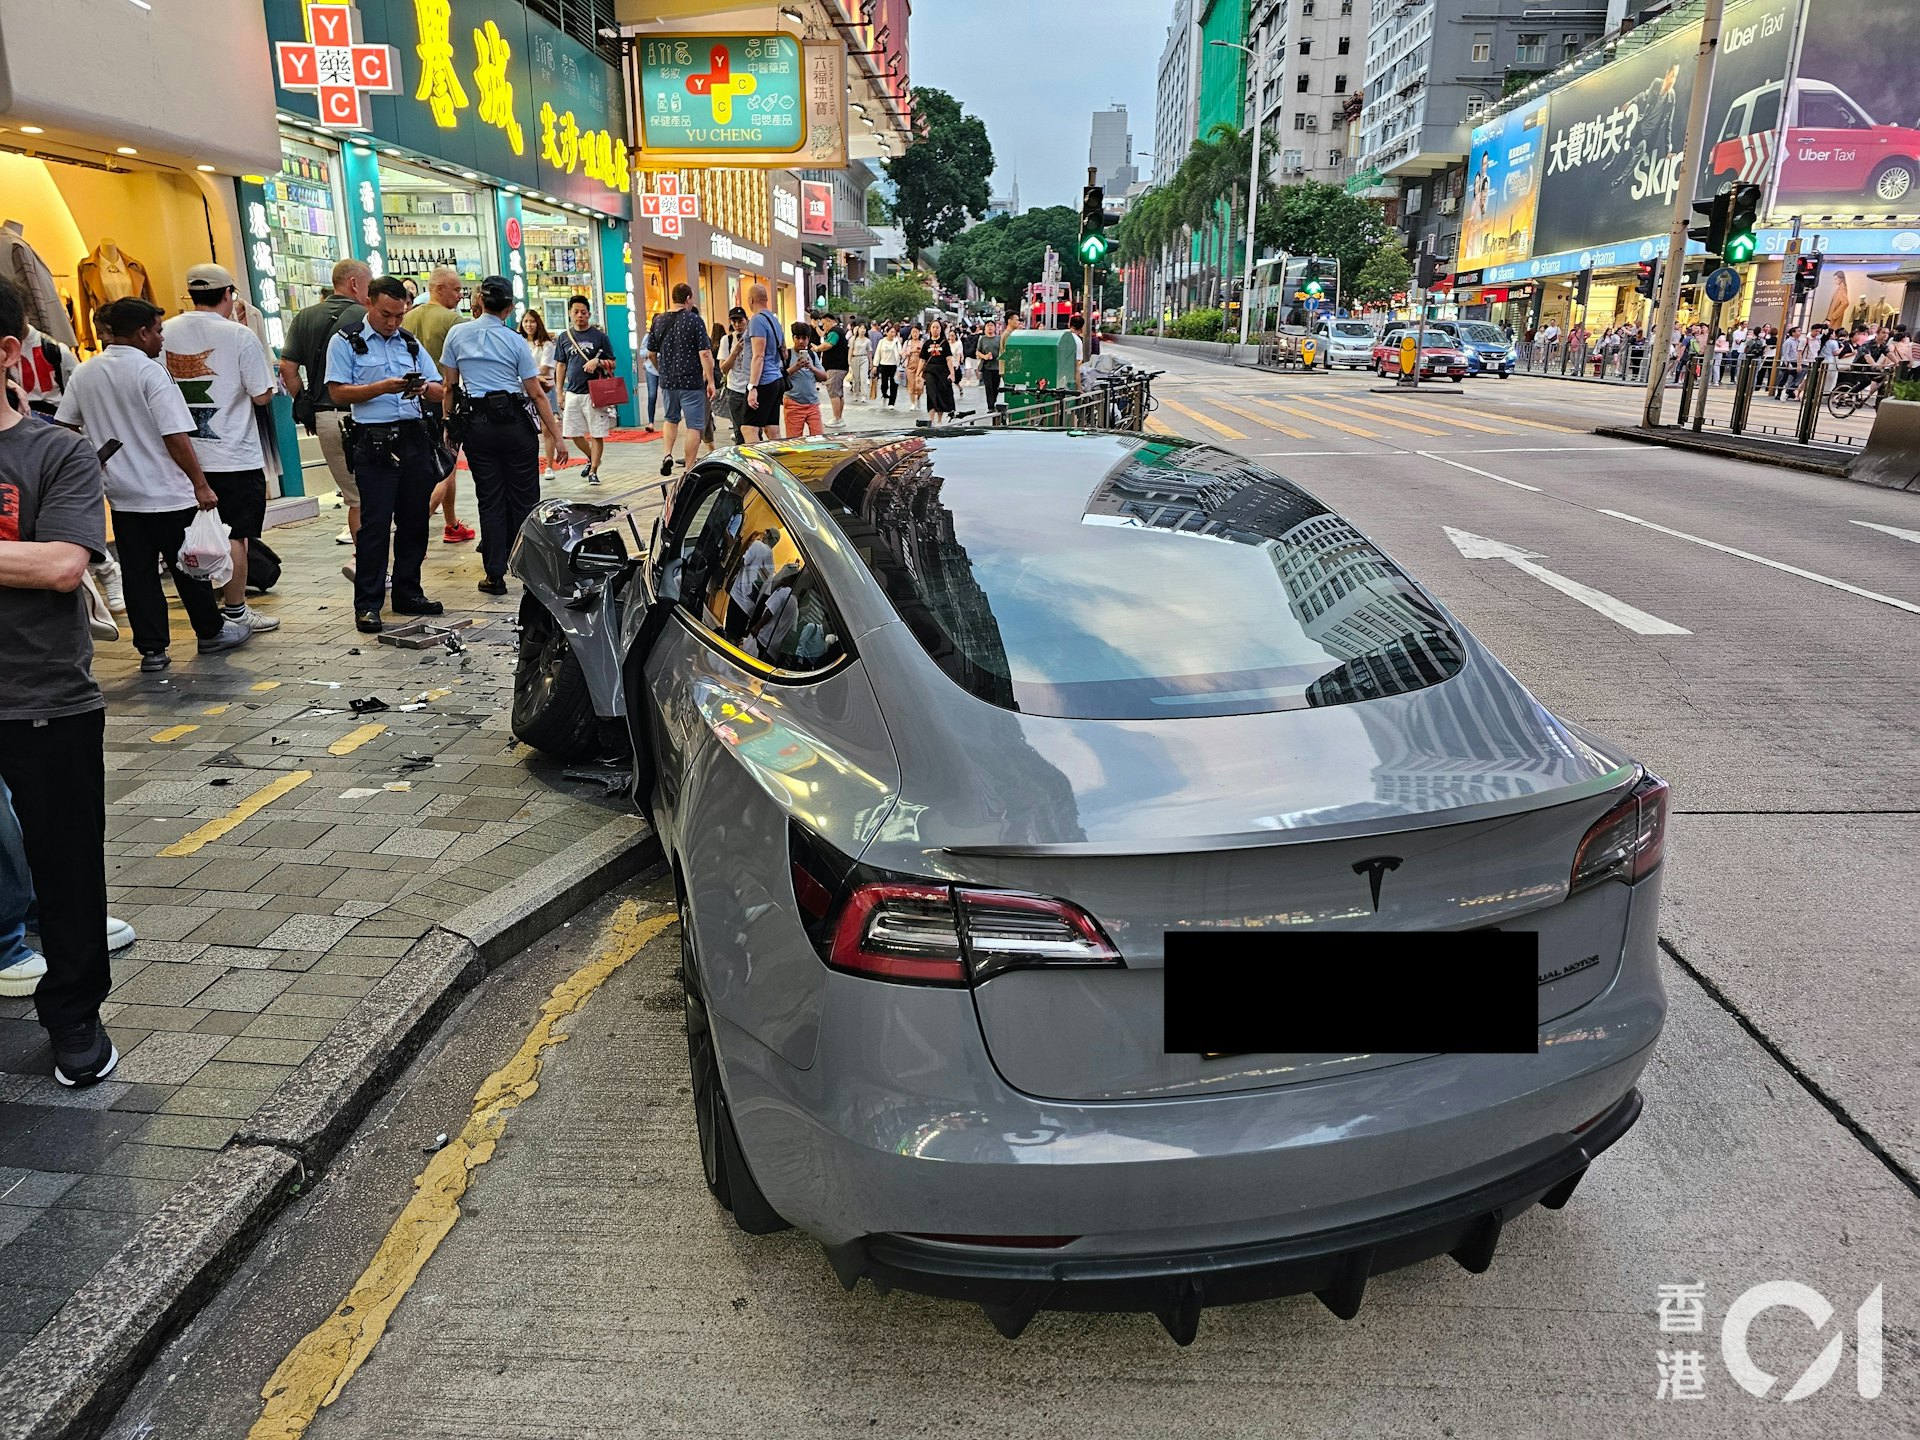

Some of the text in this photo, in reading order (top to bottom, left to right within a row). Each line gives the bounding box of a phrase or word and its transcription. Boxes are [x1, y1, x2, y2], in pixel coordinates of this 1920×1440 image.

[319, 15, 340, 40] Y
[1723, 7, 1786, 54] Uber Taxi
[288, 53, 308, 78] Y
[318, 49, 352, 84] 藥
[361, 55, 382, 80] C
[714, 55, 725, 68] Y
[747, 61, 790, 74] 中醫藥品
[694, 78, 705, 91] Y
[738, 79, 747, 90] C
[813, 55, 827, 116] 六福珠寶
[330, 92, 351, 117] C
[718, 101, 727, 112] C
[650, 115, 692, 127] 保健產品
[751, 114, 793, 126] 母嬰產品
[686, 128, 763, 142] YU CHENG
[1547, 103, 1639, 176] 大費功夫?
[1798, 148, 1856, 161] Uber Taxi
[1631, 148, 1684, 206] Skip
[662, 179, 673, 193] Y
[646, 199, 657, 212] Y
[682, 199, 693, 213] C
[665, 218, 677, 231] C
[1656, 239, 1670, 258] sha
[1765, 232, 1829, 251] shma
[1592, 250, 1616, 265] shama
[1497, 266, 1515, 280] shama
[1541, 259, 1560, 274] shama
[1538, 954, 1600, 982] UAL MOTOR
